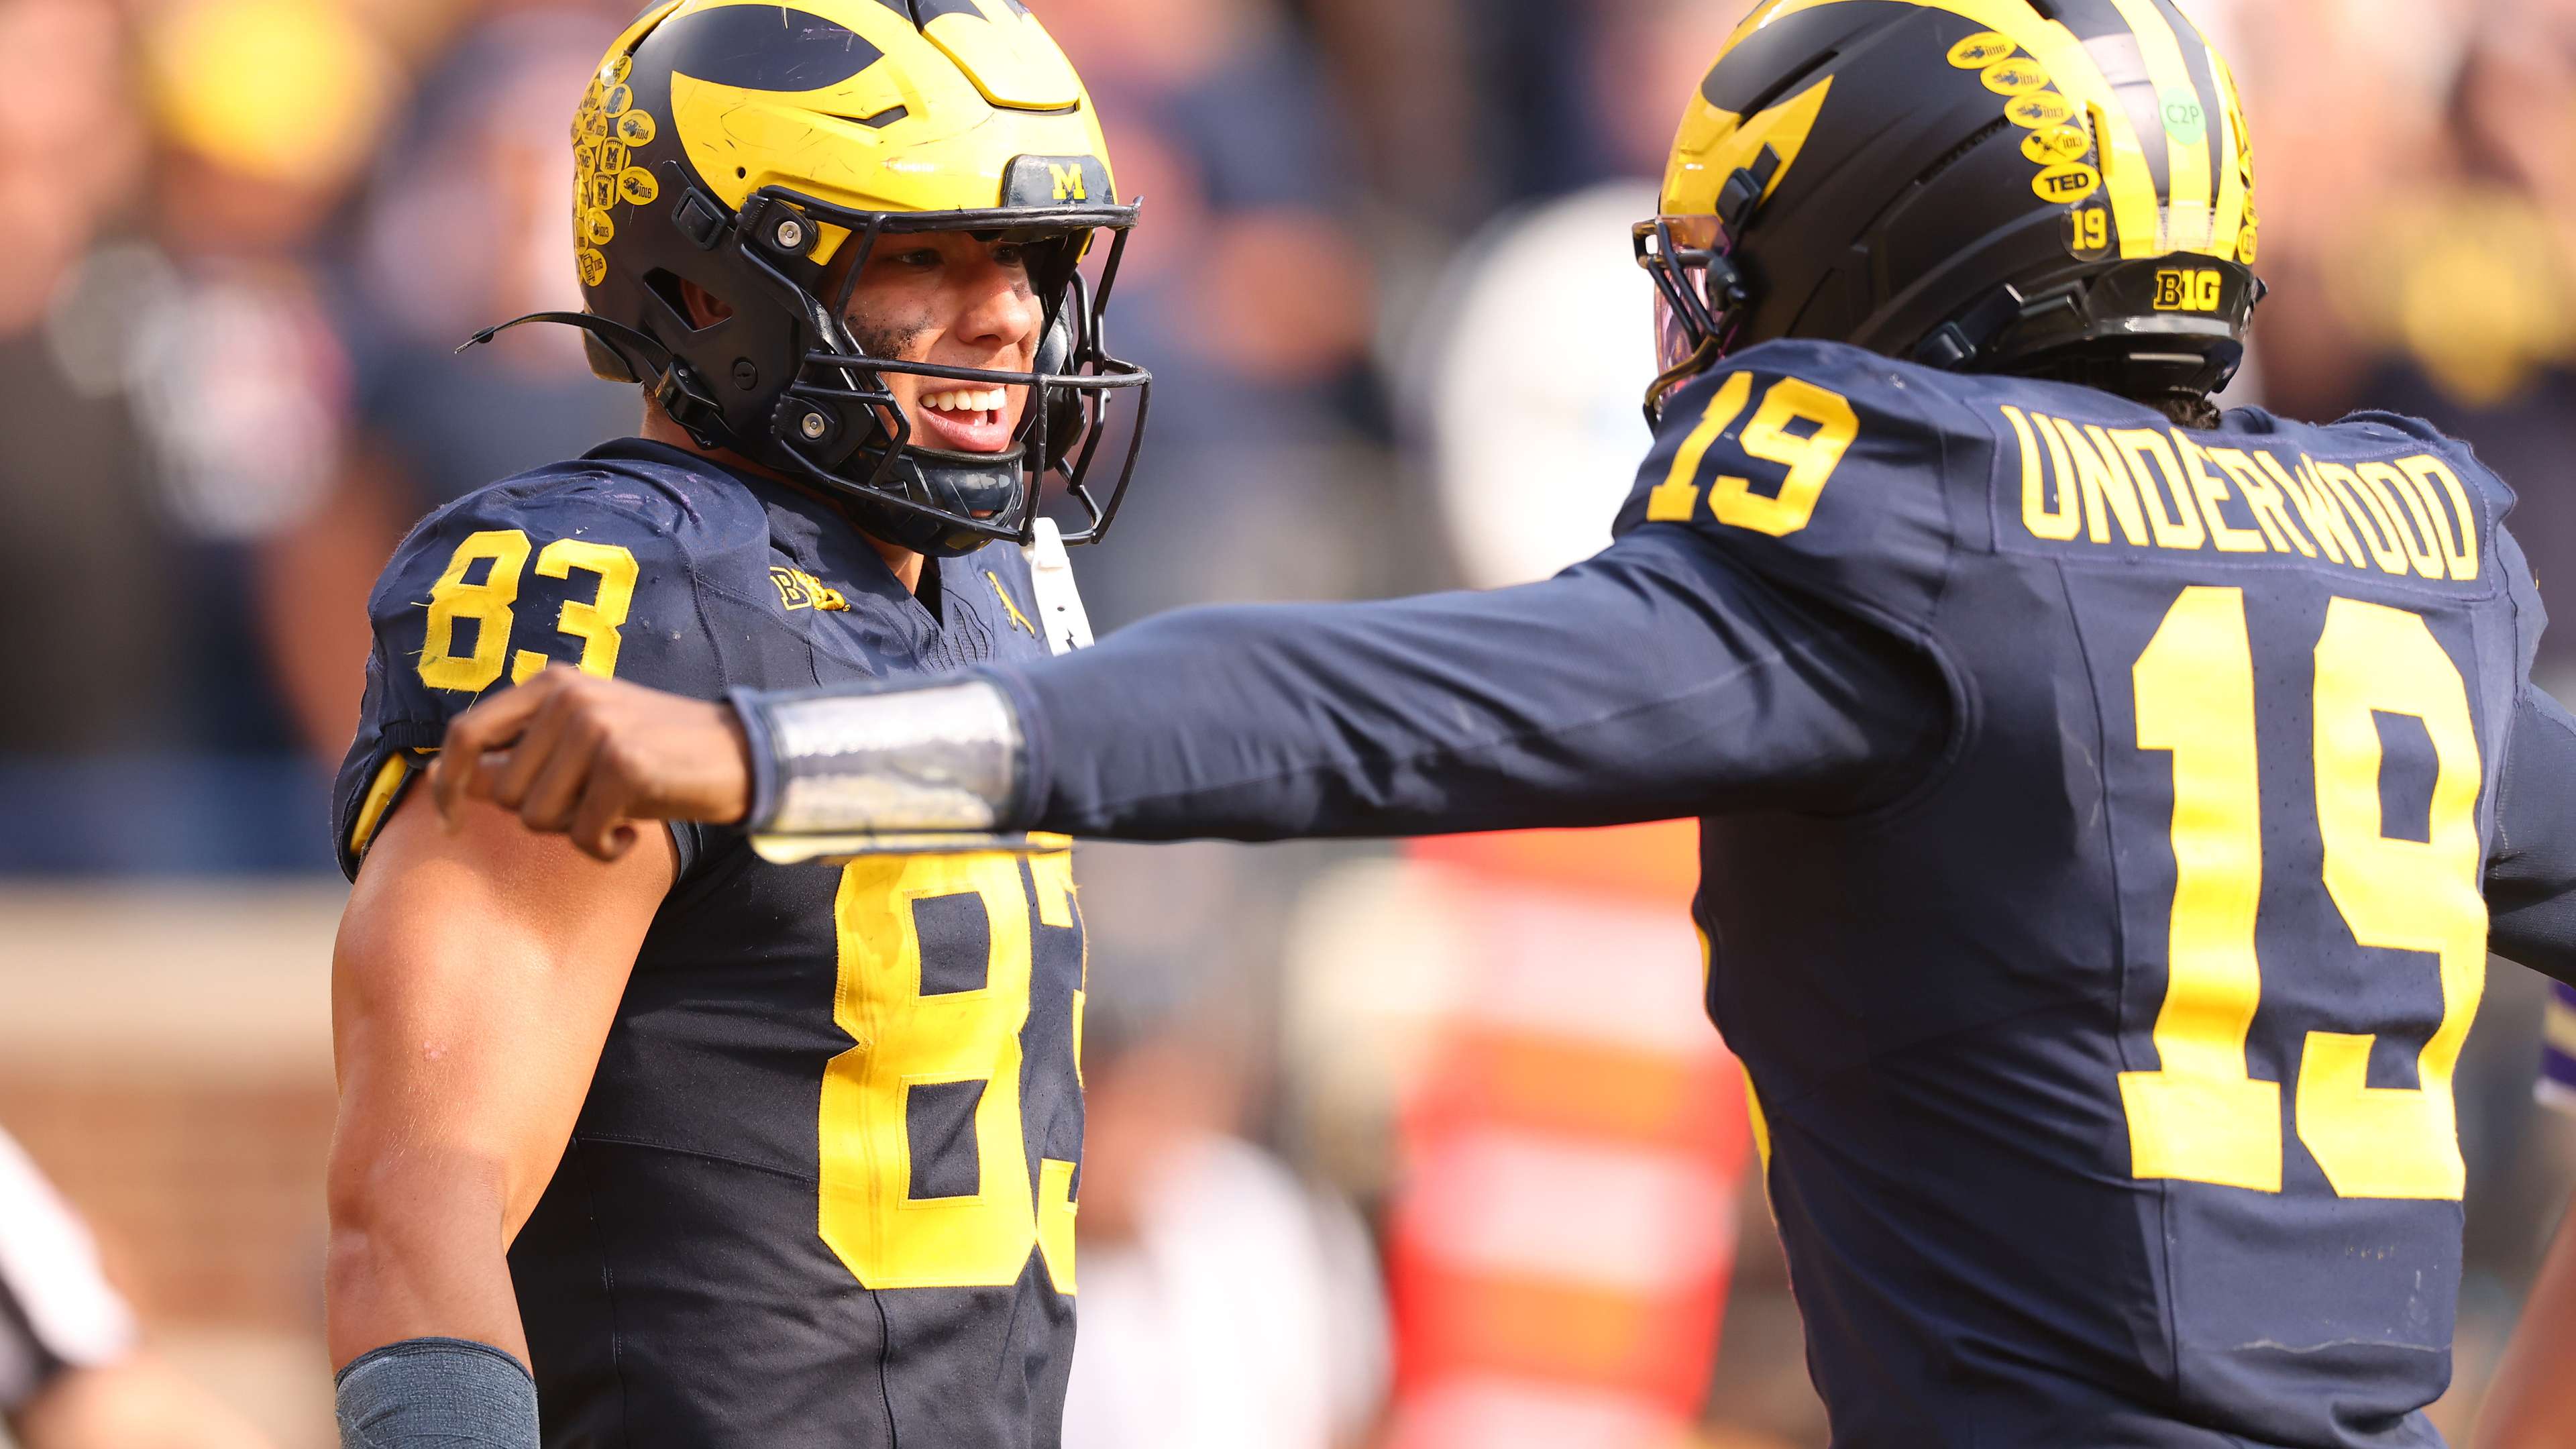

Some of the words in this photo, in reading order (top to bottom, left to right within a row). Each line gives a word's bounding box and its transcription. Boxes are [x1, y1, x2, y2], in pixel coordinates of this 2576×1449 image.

[2166, 103, 2200, 123] C2P
[635, 128, 649, 140] 1014
[639, 184, 653, 199] 1016
[1048, 163, 1087, 199] M
[2045, 172, 2089, 194] TED
[2070, 207, 2108, 250] 19
[1646, 370, 1860, 537] 19
[2000, 405, 2479, 581] UNDERWOOD
[417, 529, 639, 692] 83
[2118, 585, 2489, 1201] 19
